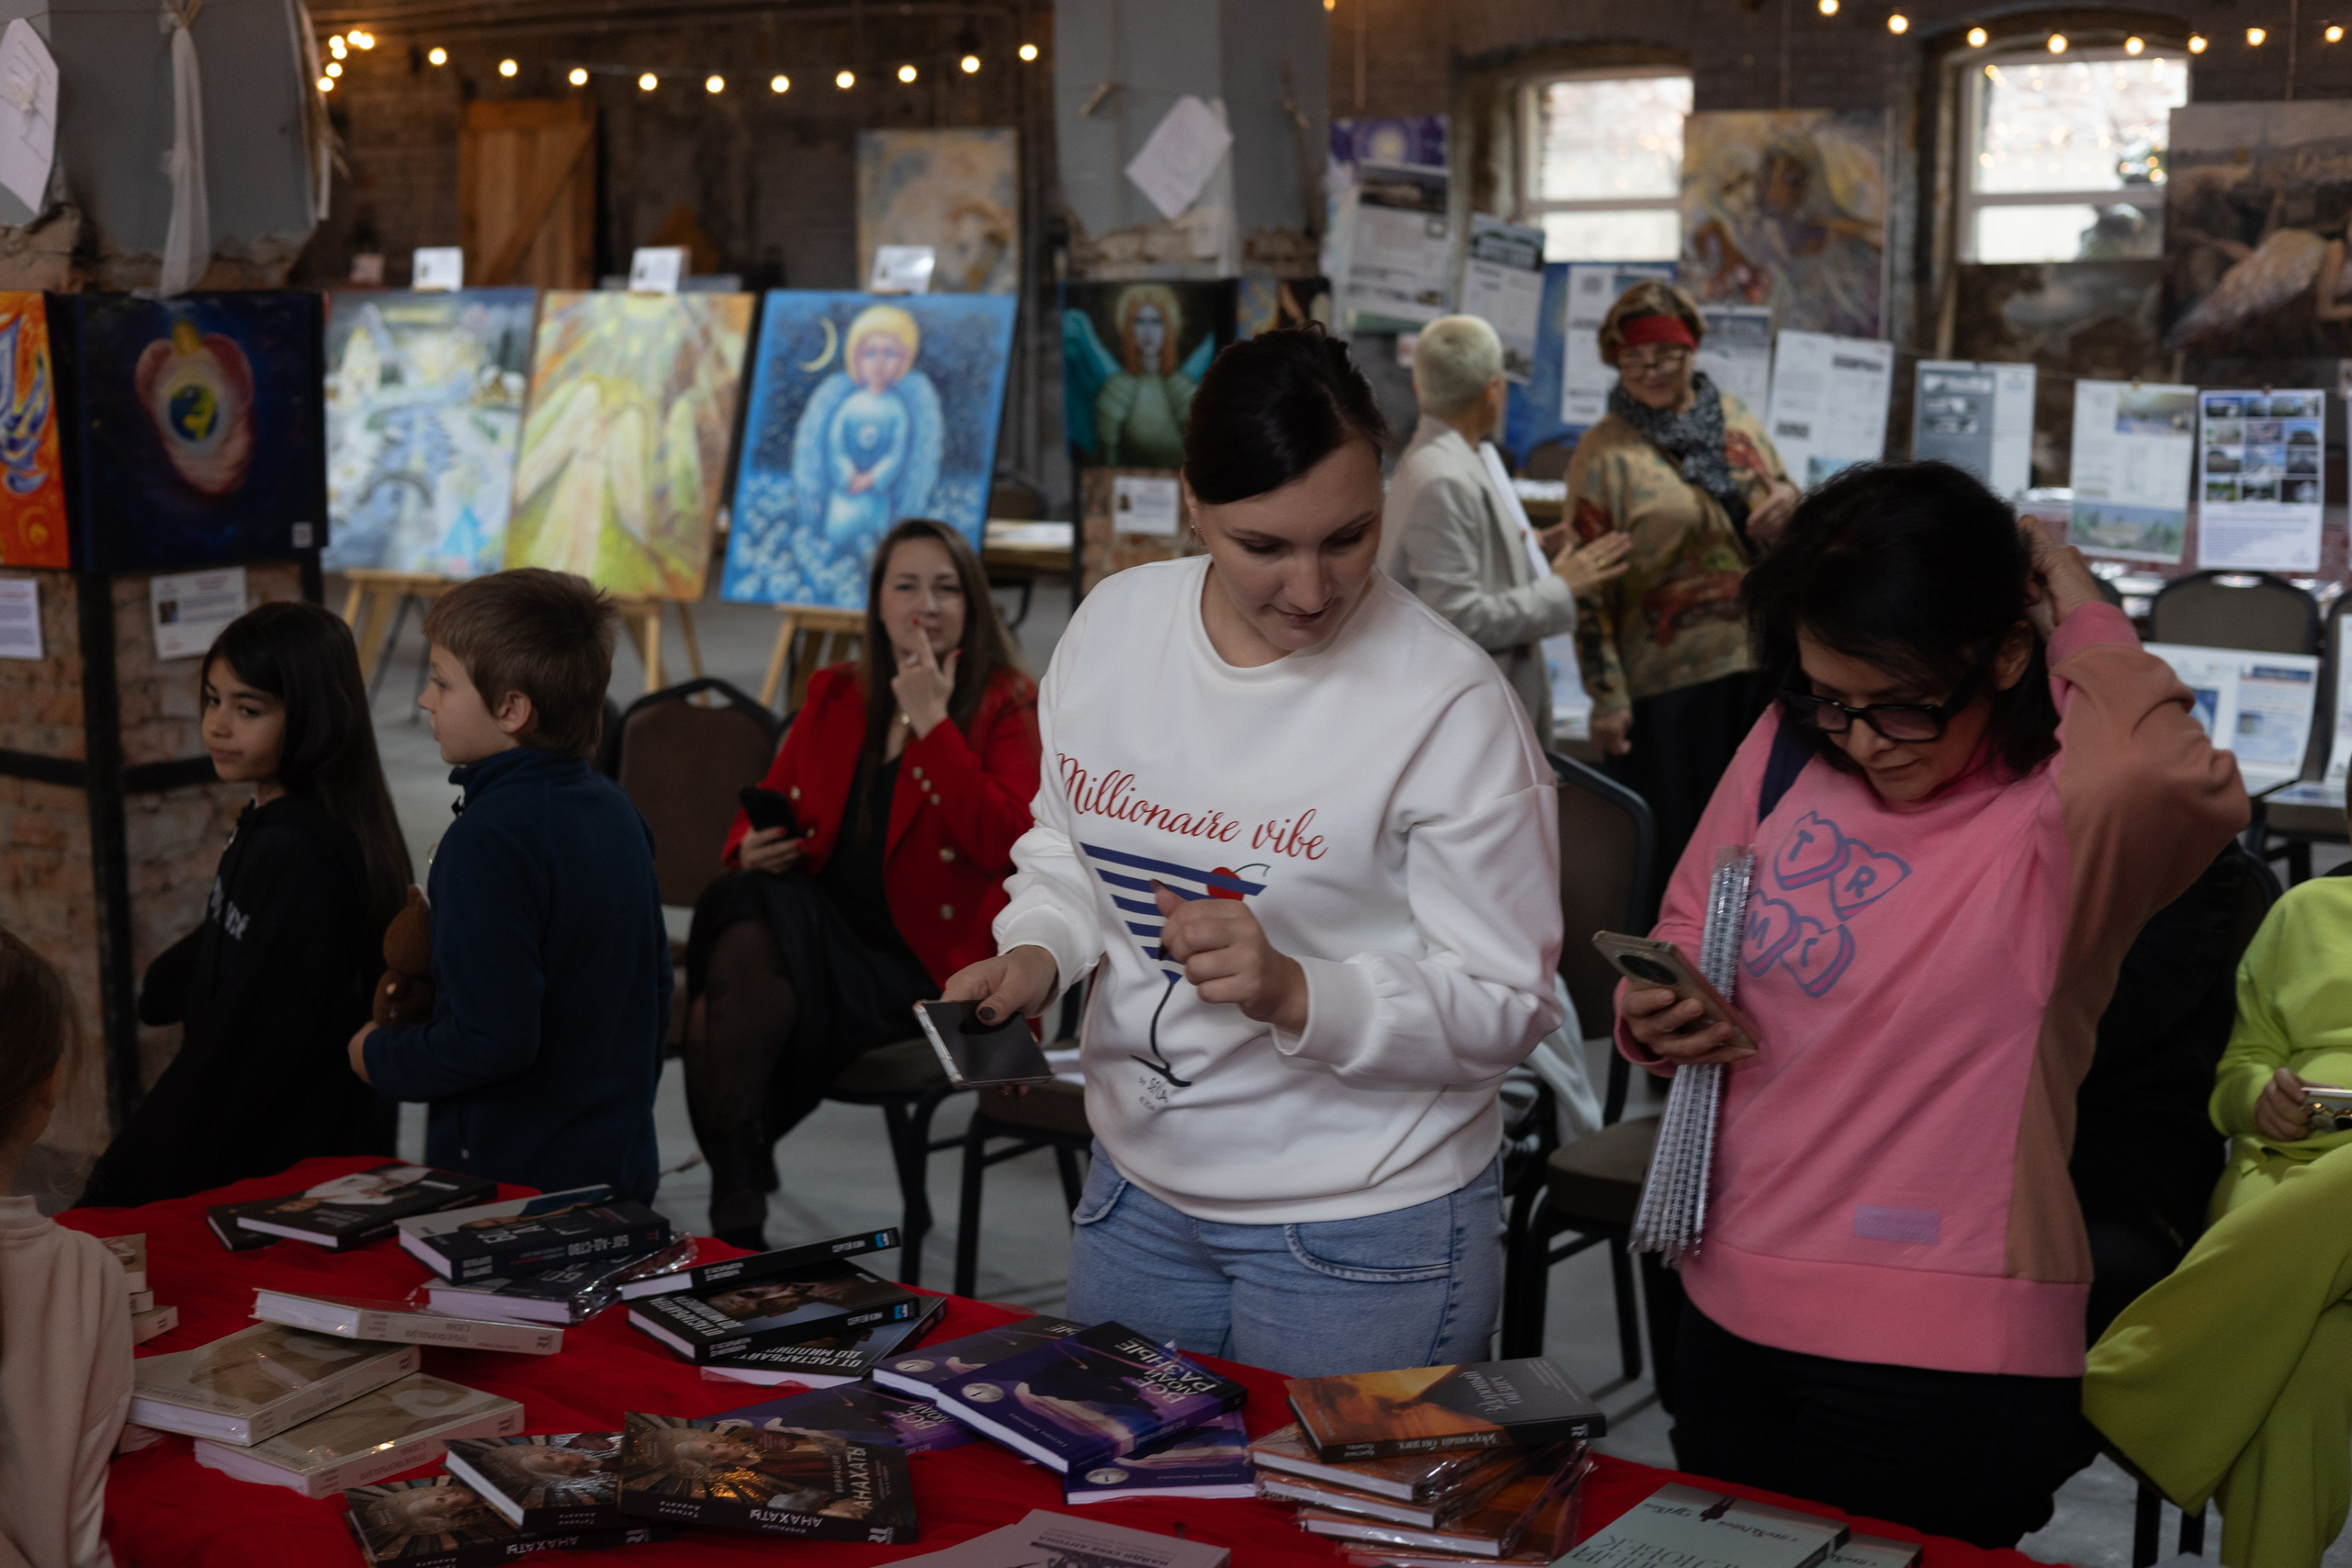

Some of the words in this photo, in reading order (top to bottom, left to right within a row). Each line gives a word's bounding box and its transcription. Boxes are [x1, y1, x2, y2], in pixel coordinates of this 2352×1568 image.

[1057, 752, 1242, 843] Millionaire
[1251, 807, 1329, 861] vibe
[732, 1351, 838, 1367] ГАСТАРБАЙТ
[834, 1350, 864, 1359] ДО
[837, 1359, 864, 1368] ОТ
[1113, 1339, 1218, 1393] РАЗНЫЕ
[1130, 1376, 1187, 1404] ВСЕ
[1143, 1369, 1199, 1395] ЛЮДИ
[890, 1410, 939, 1430] ВСЕ
[846, 1446, 874, 1510] АНАХАТЫ
[749, 1507, 824, 1529] АНАХАТЫ
[505, 1534, 580, 1555] АНАХАТЫ
